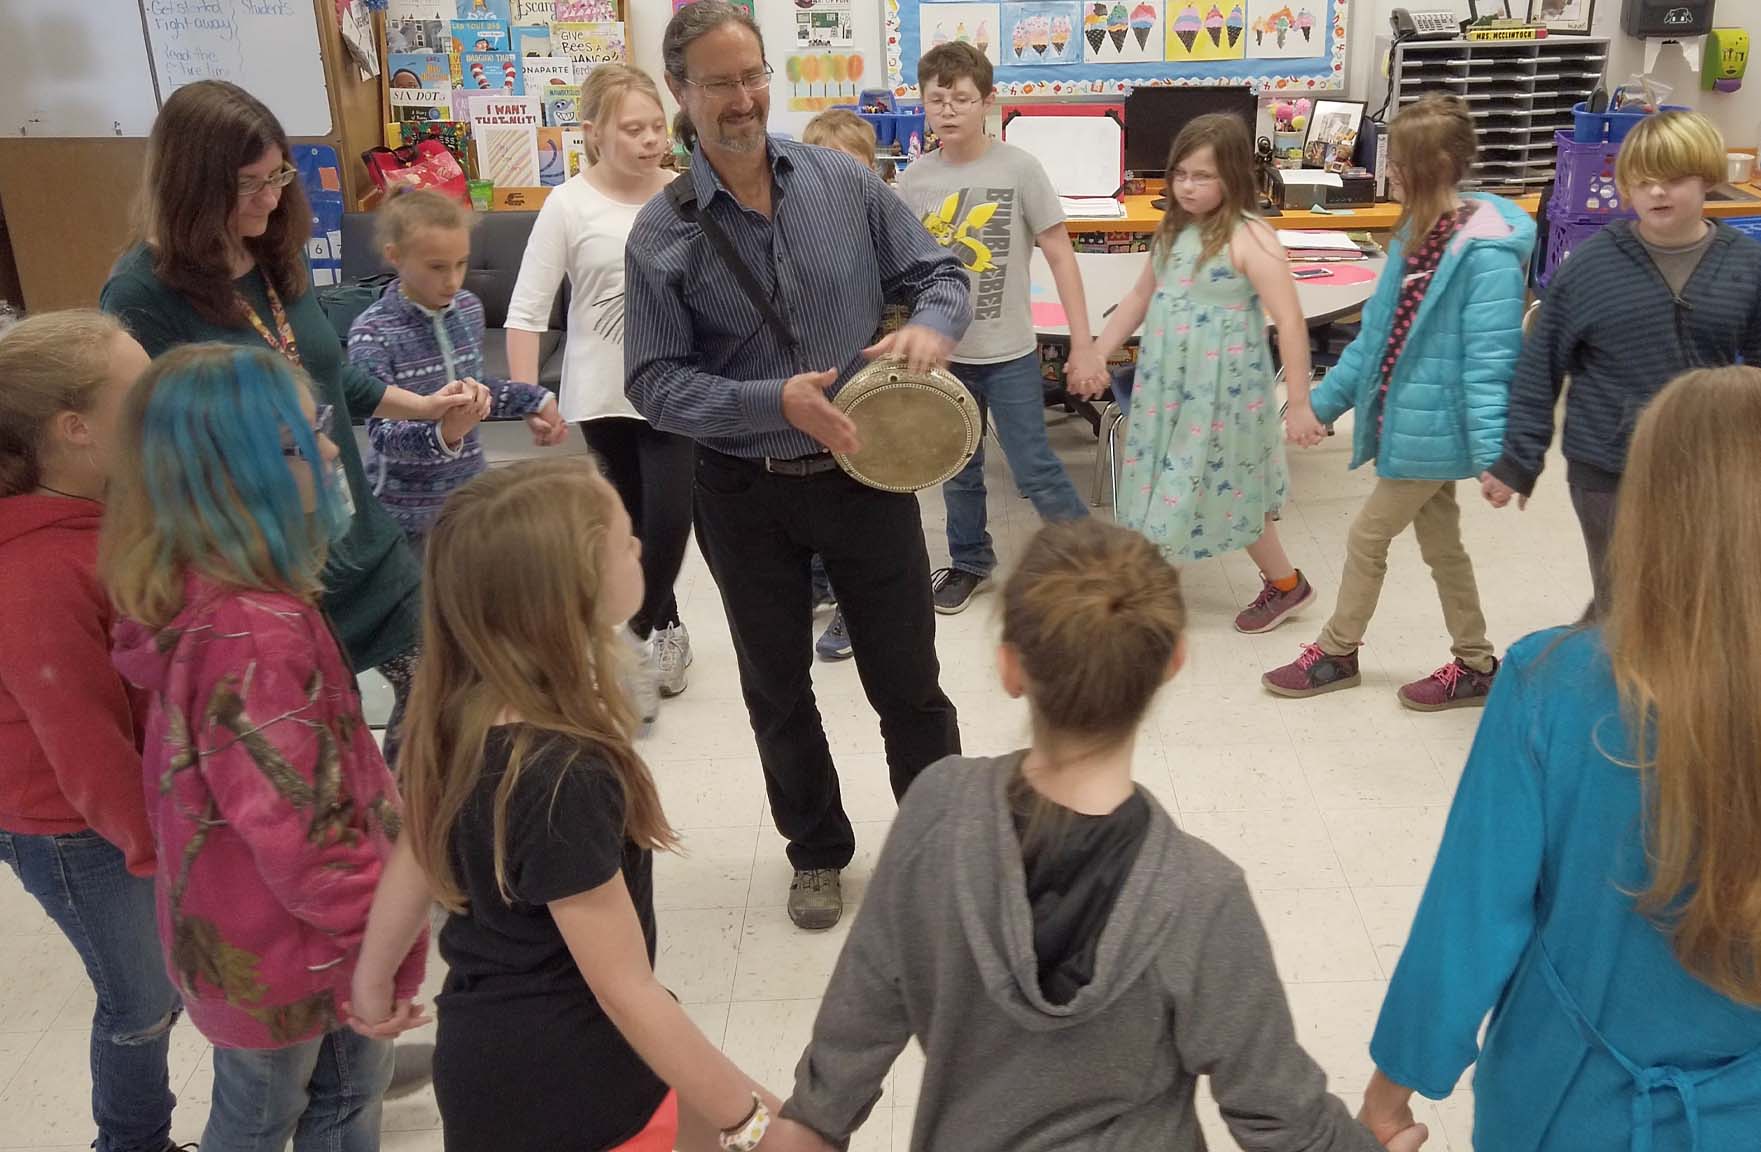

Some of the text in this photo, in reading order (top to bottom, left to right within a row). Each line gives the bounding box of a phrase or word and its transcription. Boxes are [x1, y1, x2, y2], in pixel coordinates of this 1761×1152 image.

[1476, 31, 1532, 40] MRS. MCCLINTOCK
[495, 105, 527, 115] WANT
[315, 243, 323, 255] 6
